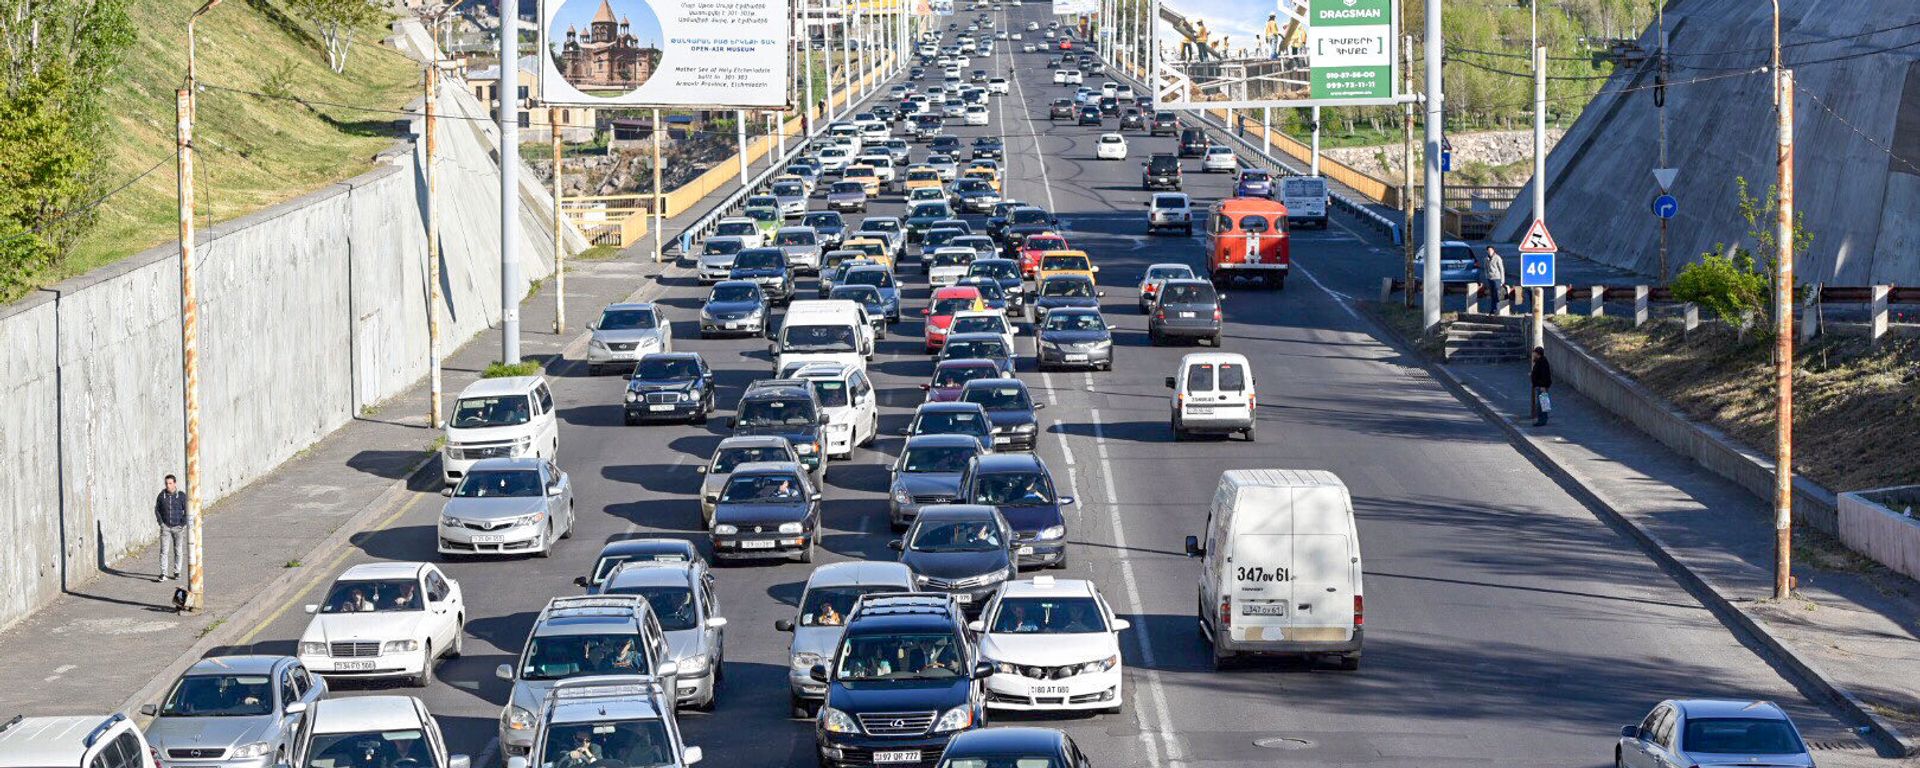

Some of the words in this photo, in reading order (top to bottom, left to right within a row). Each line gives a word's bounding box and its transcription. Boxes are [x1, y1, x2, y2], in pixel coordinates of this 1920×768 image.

[1319, 9, 1381, 19] DRAGSMAN
[1328, 37, 1373, 45] ՀԻՄՔԵՐԻ
[1526, 262, 1547, 276] 40
[1276, 567, 1289, 582] 61
[1249, 605, 1261, 613] 347
[883, 752, 892, 760] 97
[905, 751, 919, 760] 777
